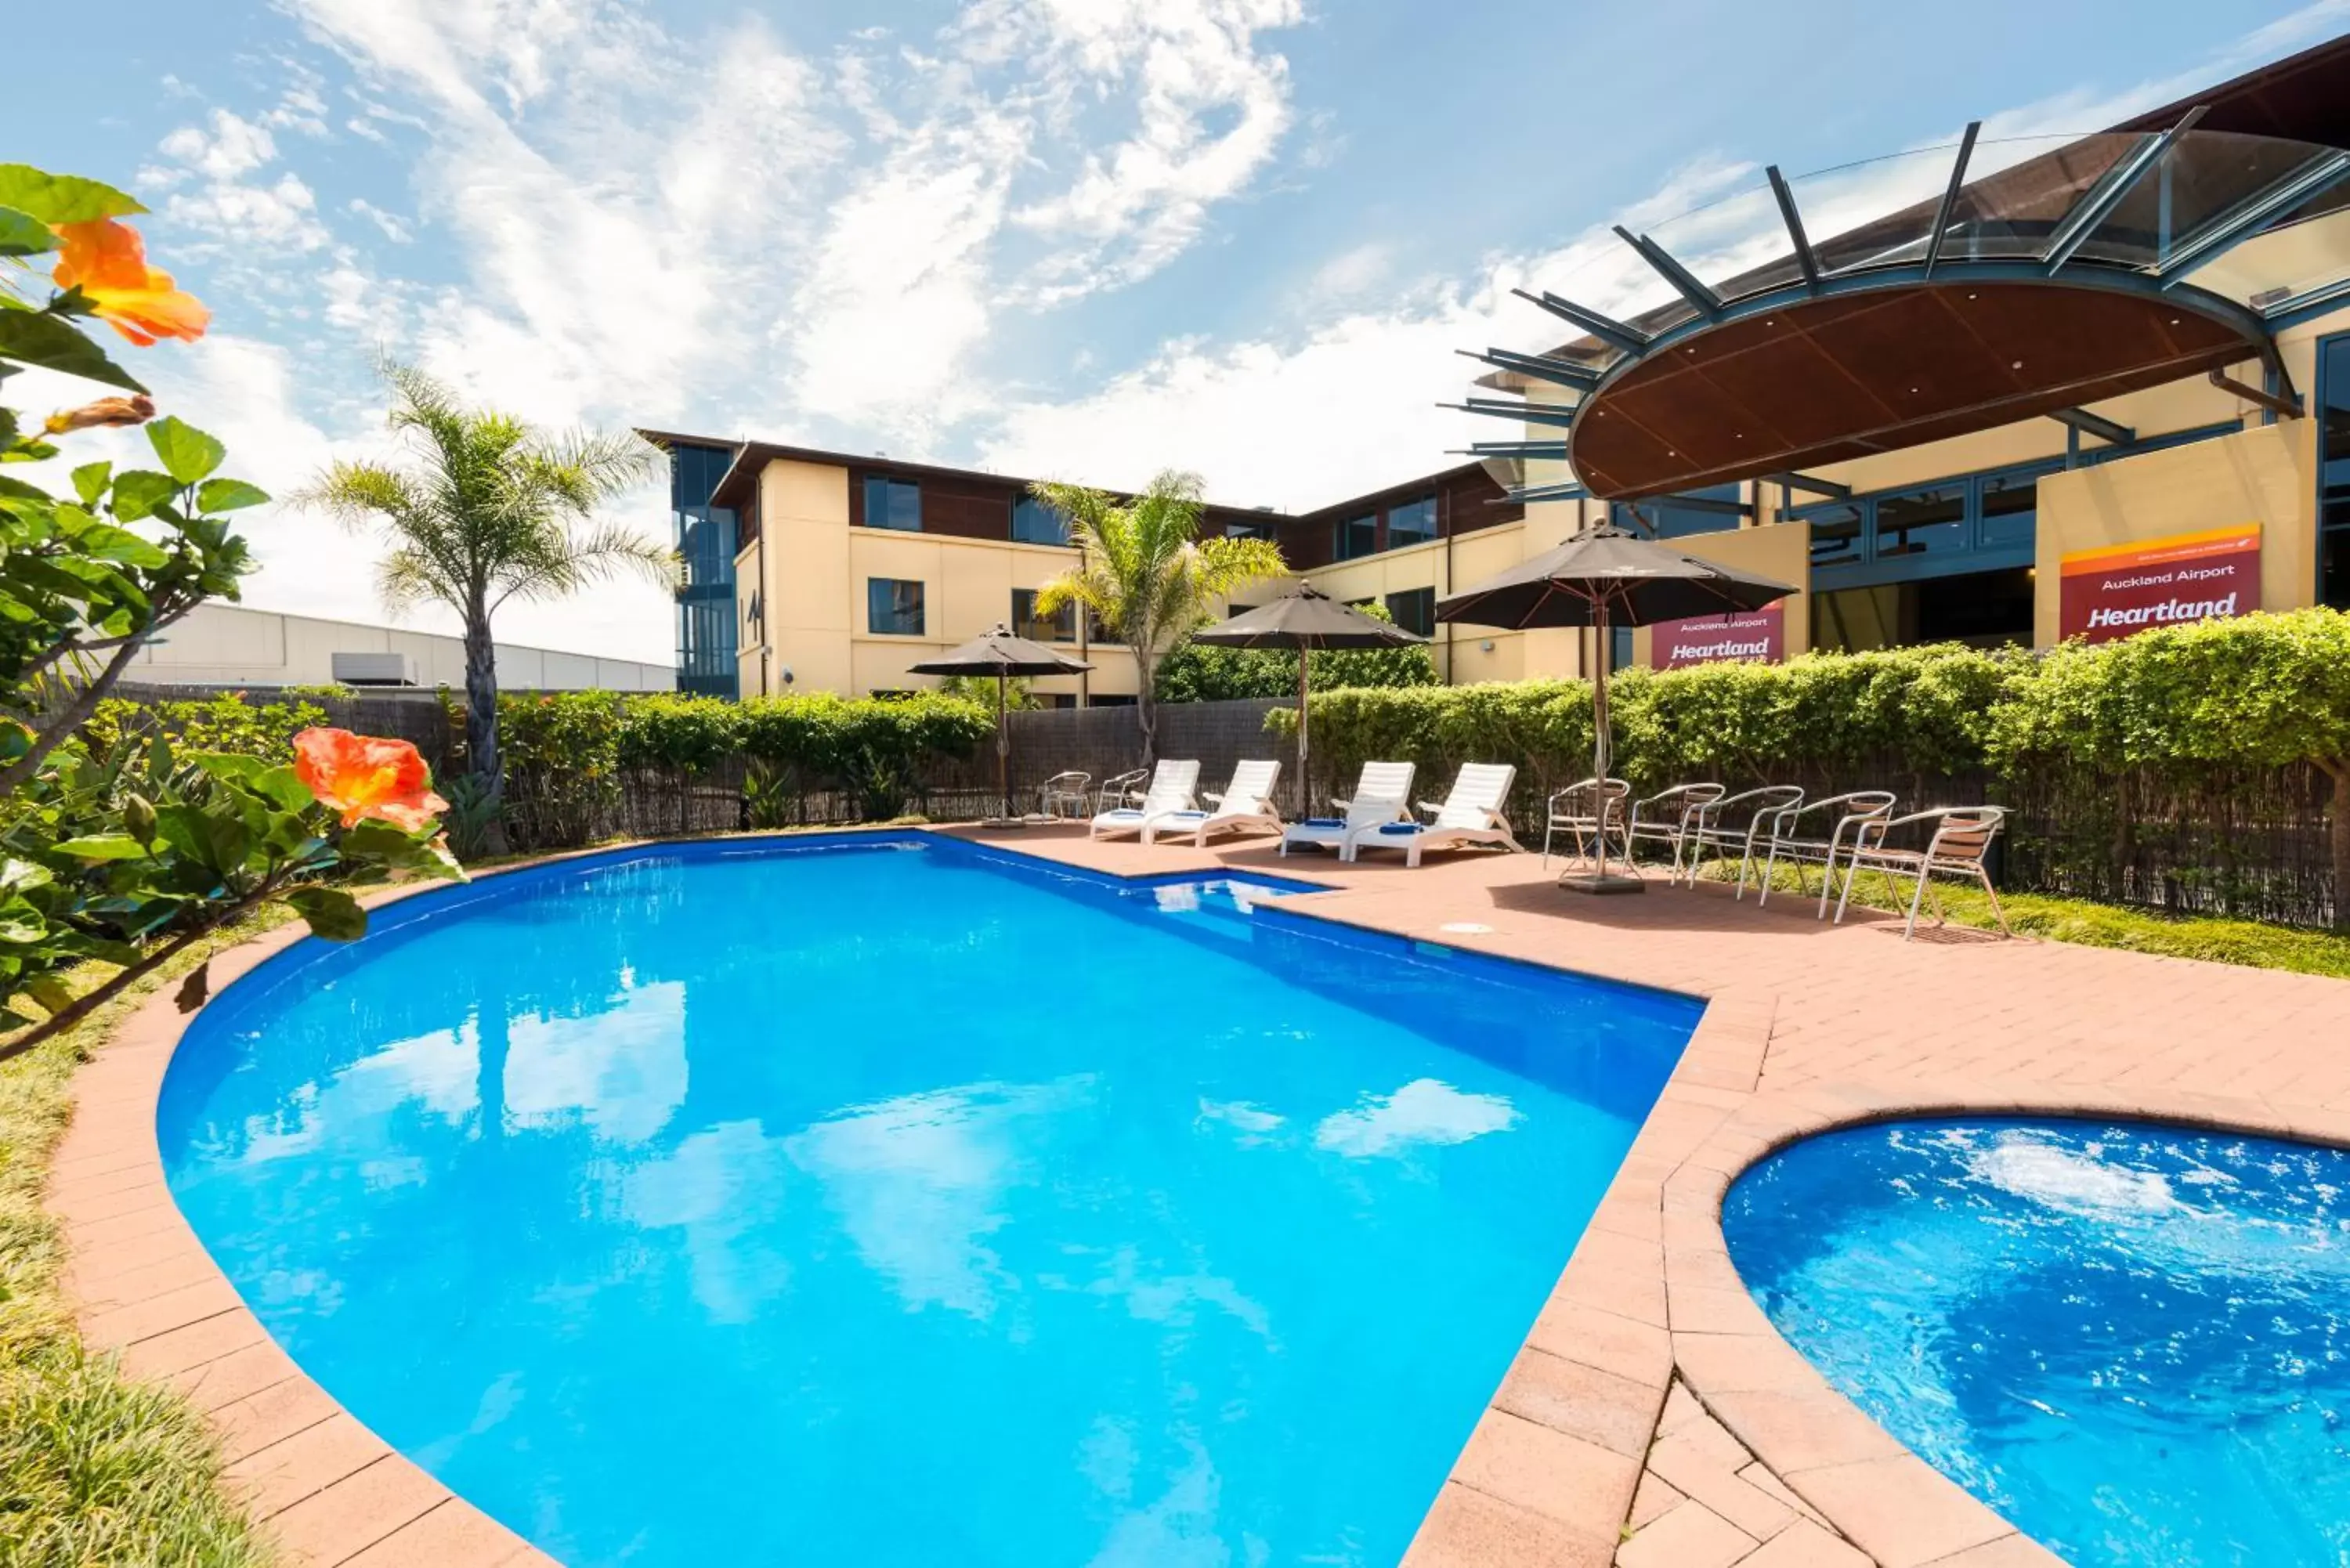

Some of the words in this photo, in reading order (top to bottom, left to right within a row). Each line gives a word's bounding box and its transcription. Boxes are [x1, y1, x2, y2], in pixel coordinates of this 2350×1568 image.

[2102, 573, 2172, 591] Auckland
[2177, 565, 2235, 580] Airport
[2087, 592, 2236, 627] Heartland
[1671, 637, 1770, 659] Heartland
